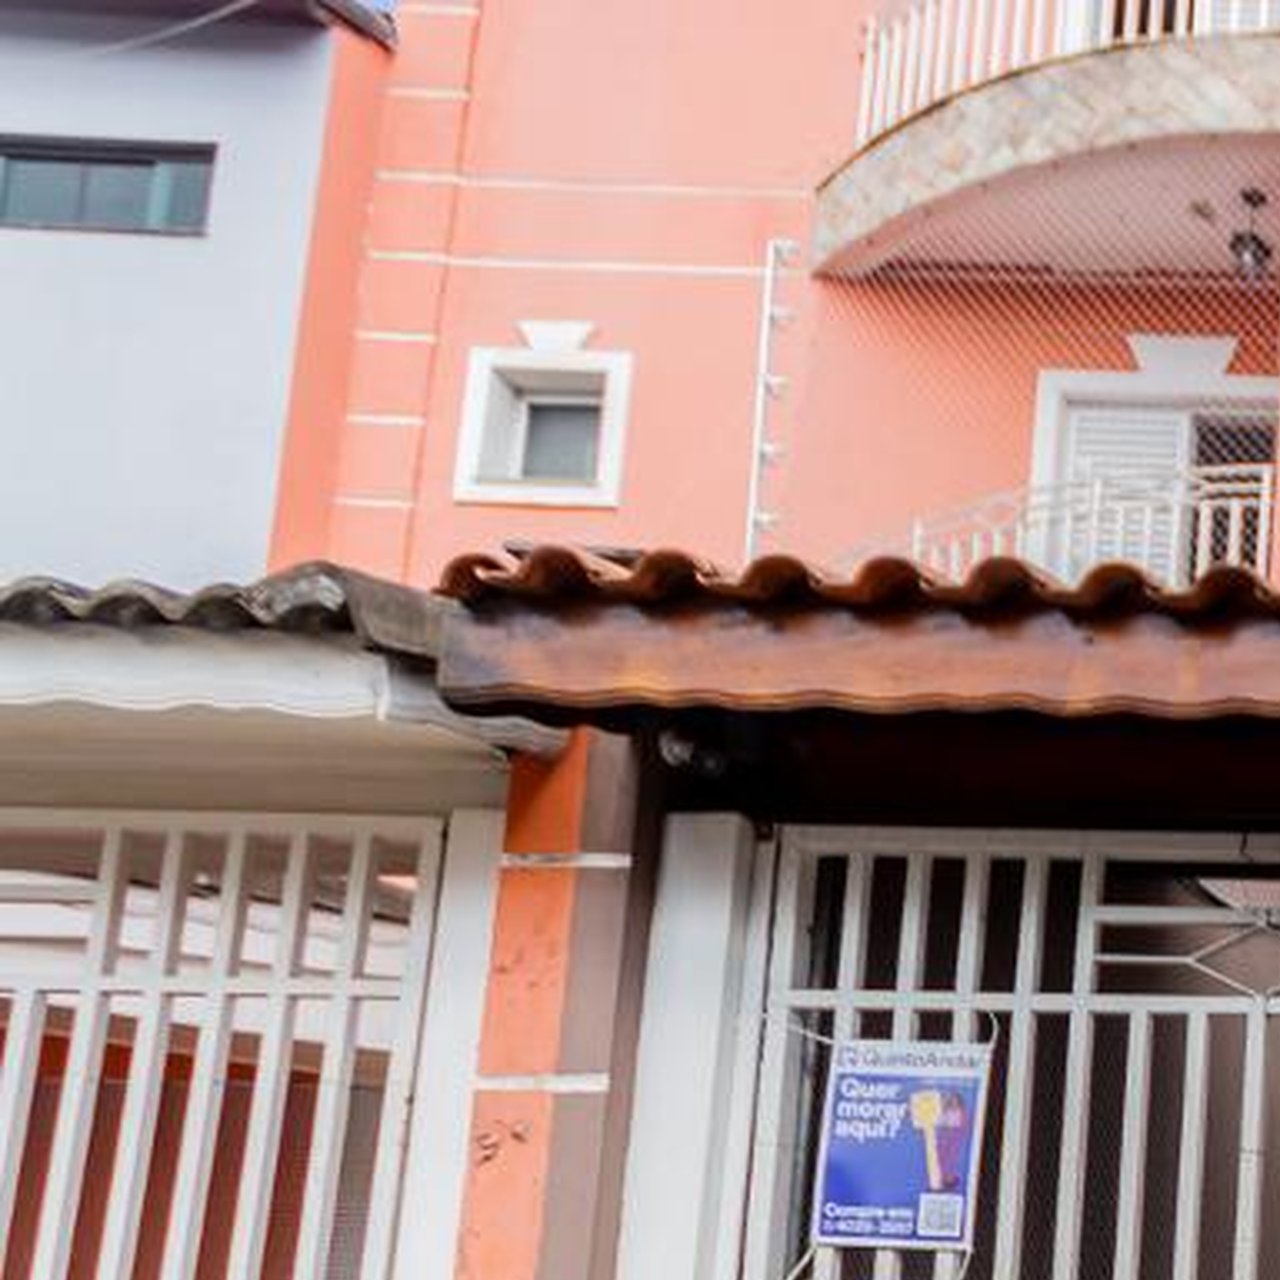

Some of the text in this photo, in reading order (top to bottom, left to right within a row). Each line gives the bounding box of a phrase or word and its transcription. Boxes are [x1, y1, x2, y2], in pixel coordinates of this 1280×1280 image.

[840, 1078, 901, 1099] Quer
[836, 1101, 907, 1119] morar
[834, 1119, 902, 1141] aqui?
